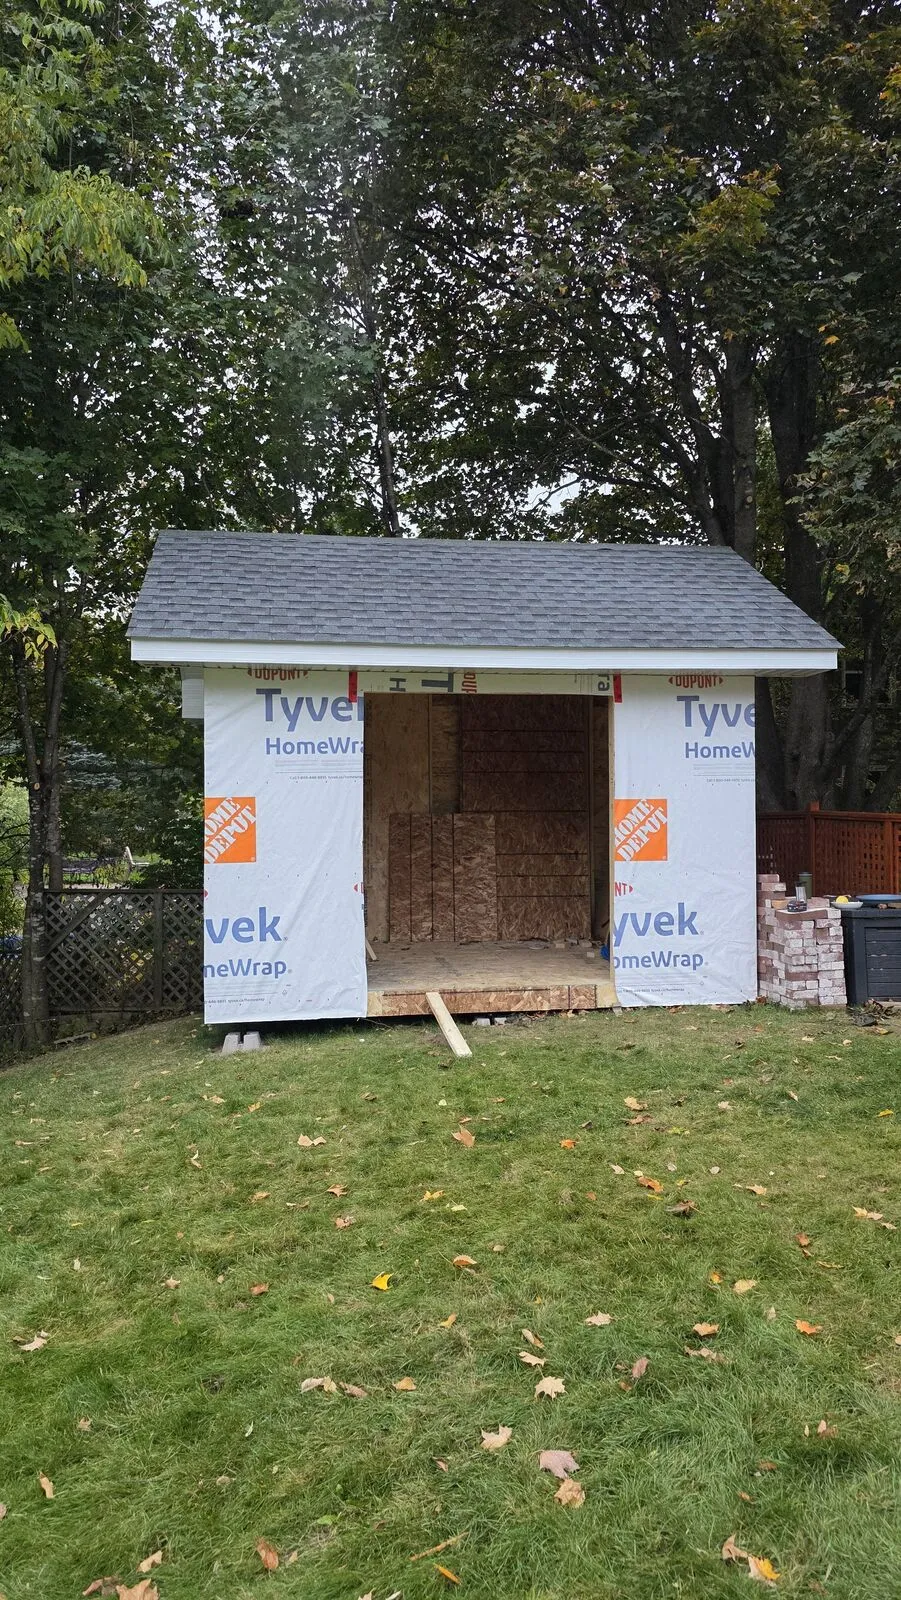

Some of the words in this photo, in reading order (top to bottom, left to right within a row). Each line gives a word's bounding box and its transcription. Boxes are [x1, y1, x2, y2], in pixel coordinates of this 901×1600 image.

[255, 668, 301, 681] DUPONT
[675, 674, 717, 688] DUPONT
[204, 797, 241, 843] OME
[204, 805, 256, 864] DEPOT
[616, 806, 667, 862] DEPOT
